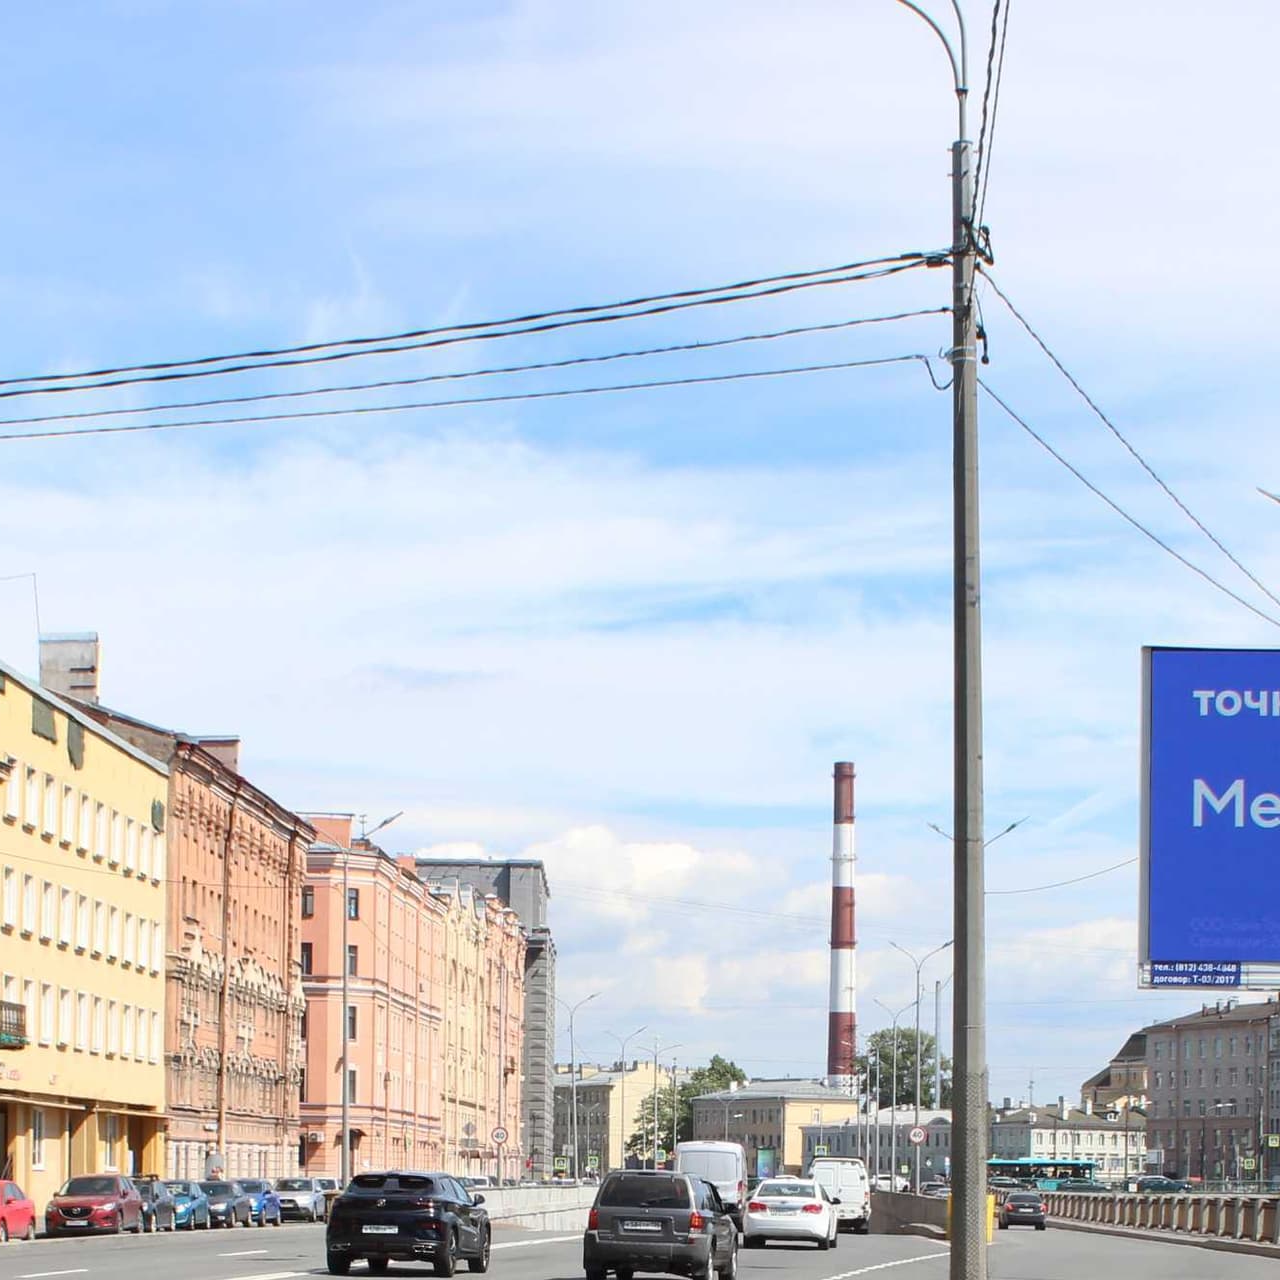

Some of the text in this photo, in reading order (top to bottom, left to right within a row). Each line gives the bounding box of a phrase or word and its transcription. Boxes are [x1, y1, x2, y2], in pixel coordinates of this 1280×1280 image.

[1175, 963, 1197, 972] (812)
[495, 1131, 505, 1140] 40
[912, 1130, 922, 1138] 40
